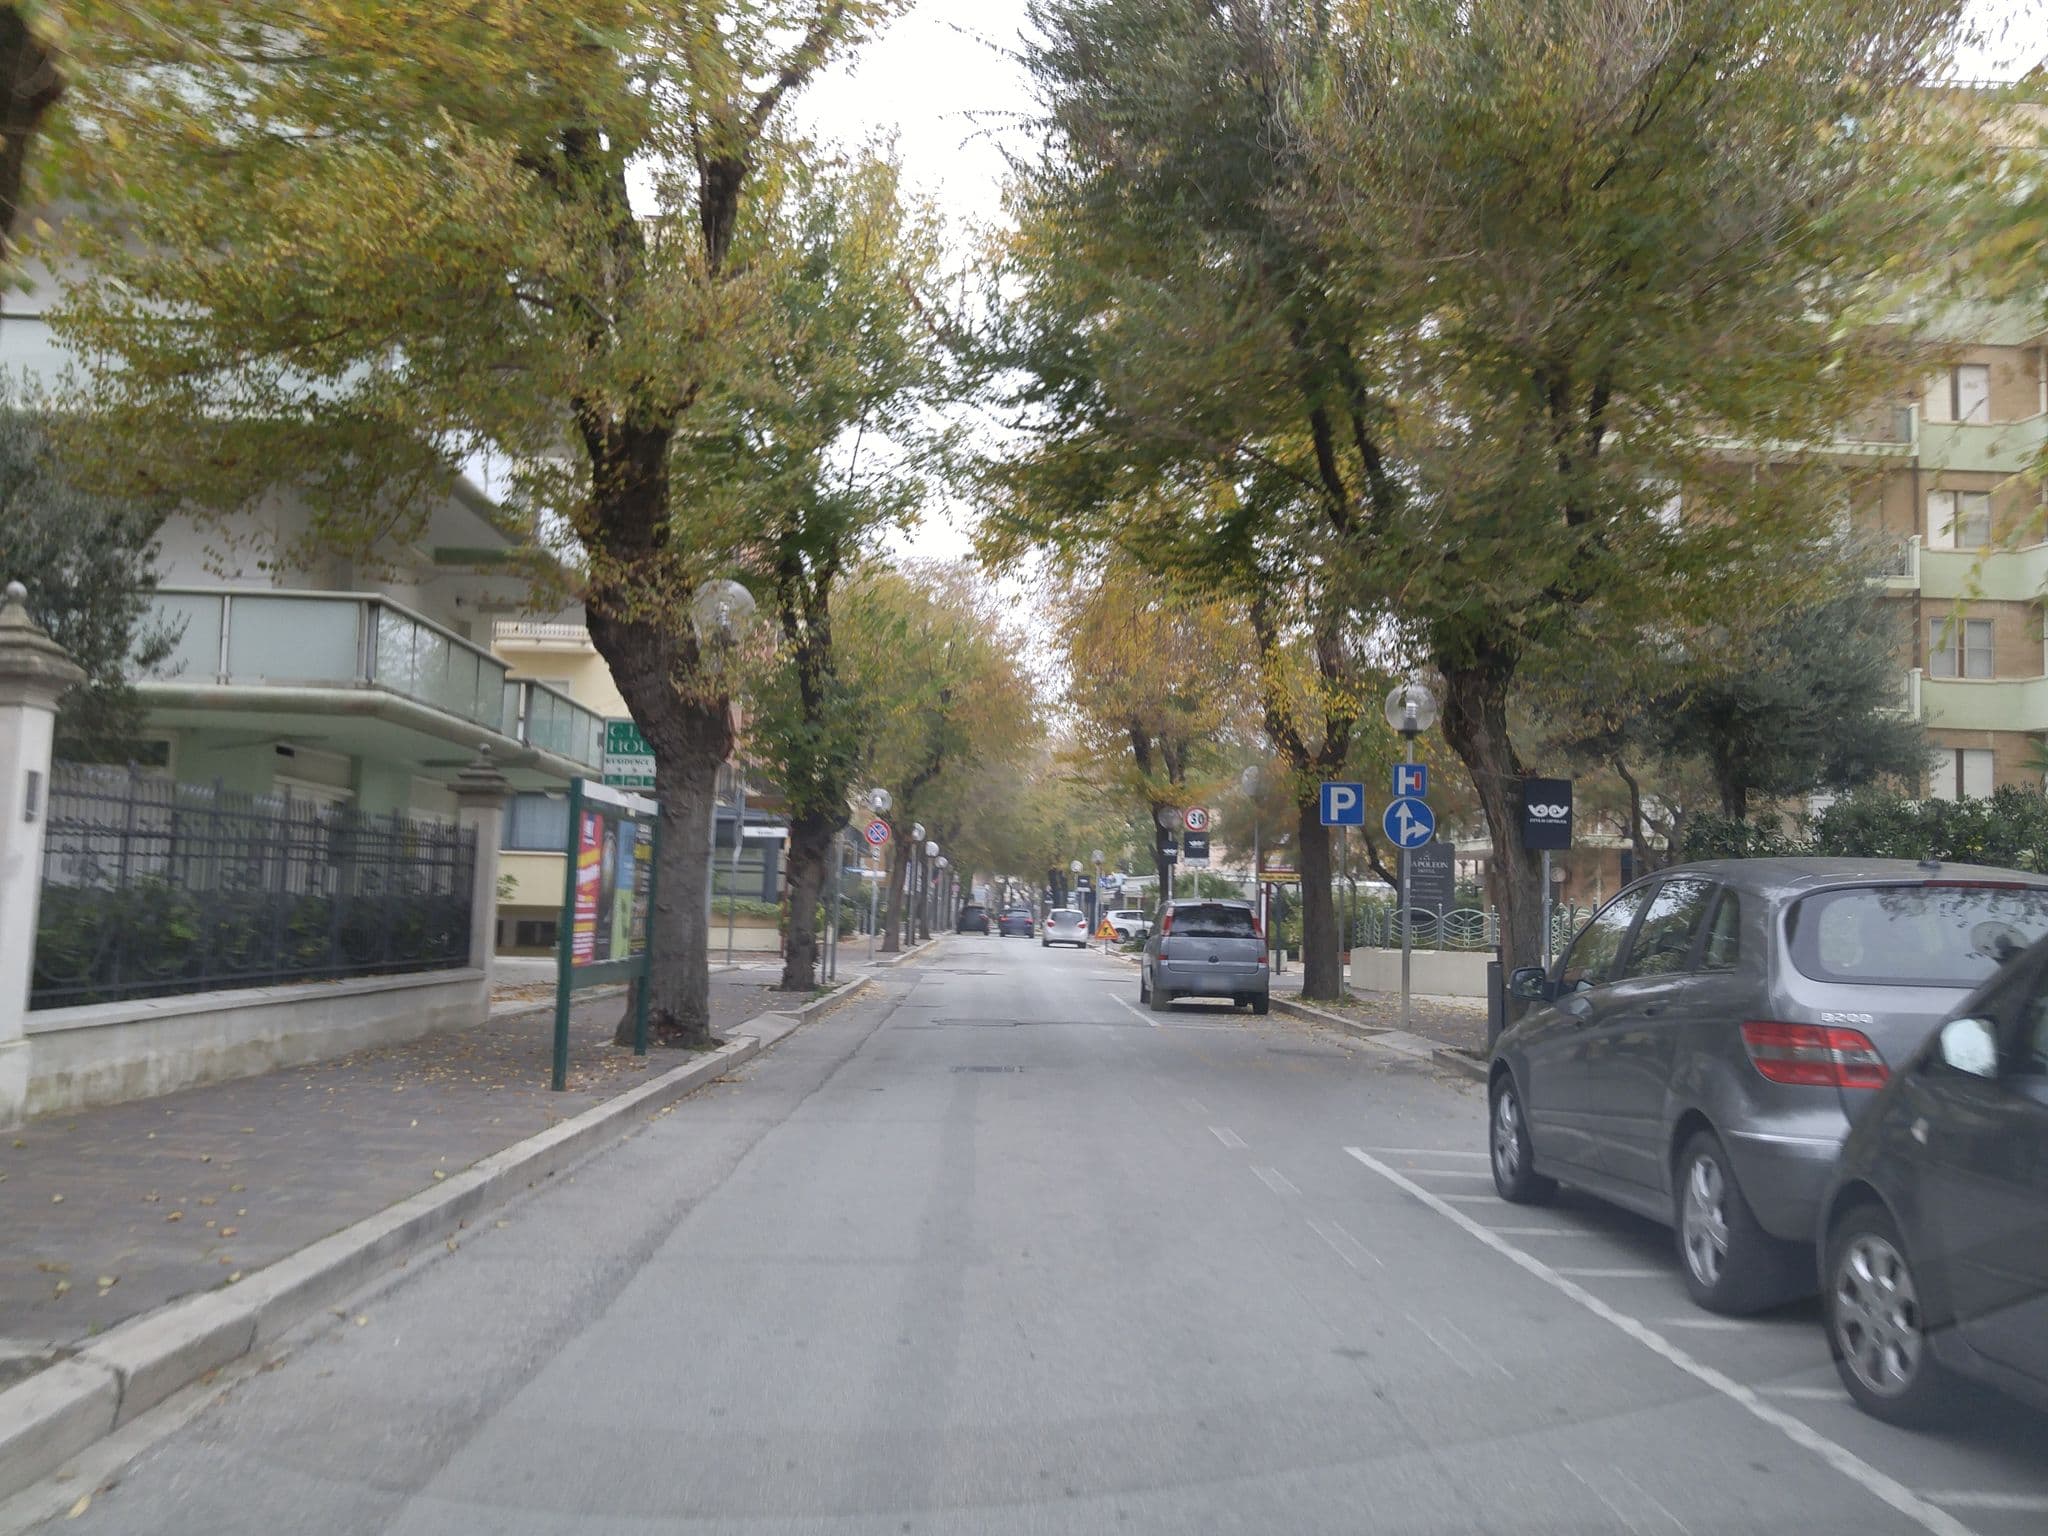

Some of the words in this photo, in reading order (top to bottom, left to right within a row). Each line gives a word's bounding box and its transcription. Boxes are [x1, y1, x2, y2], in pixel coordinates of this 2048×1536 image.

[1330, 786, 1356, 821] P
[1191, 813, 1205, 825] 30
[1411, 860, 1449, 869] APOLEON
[1821, 1012, 1873, 1024] B200
